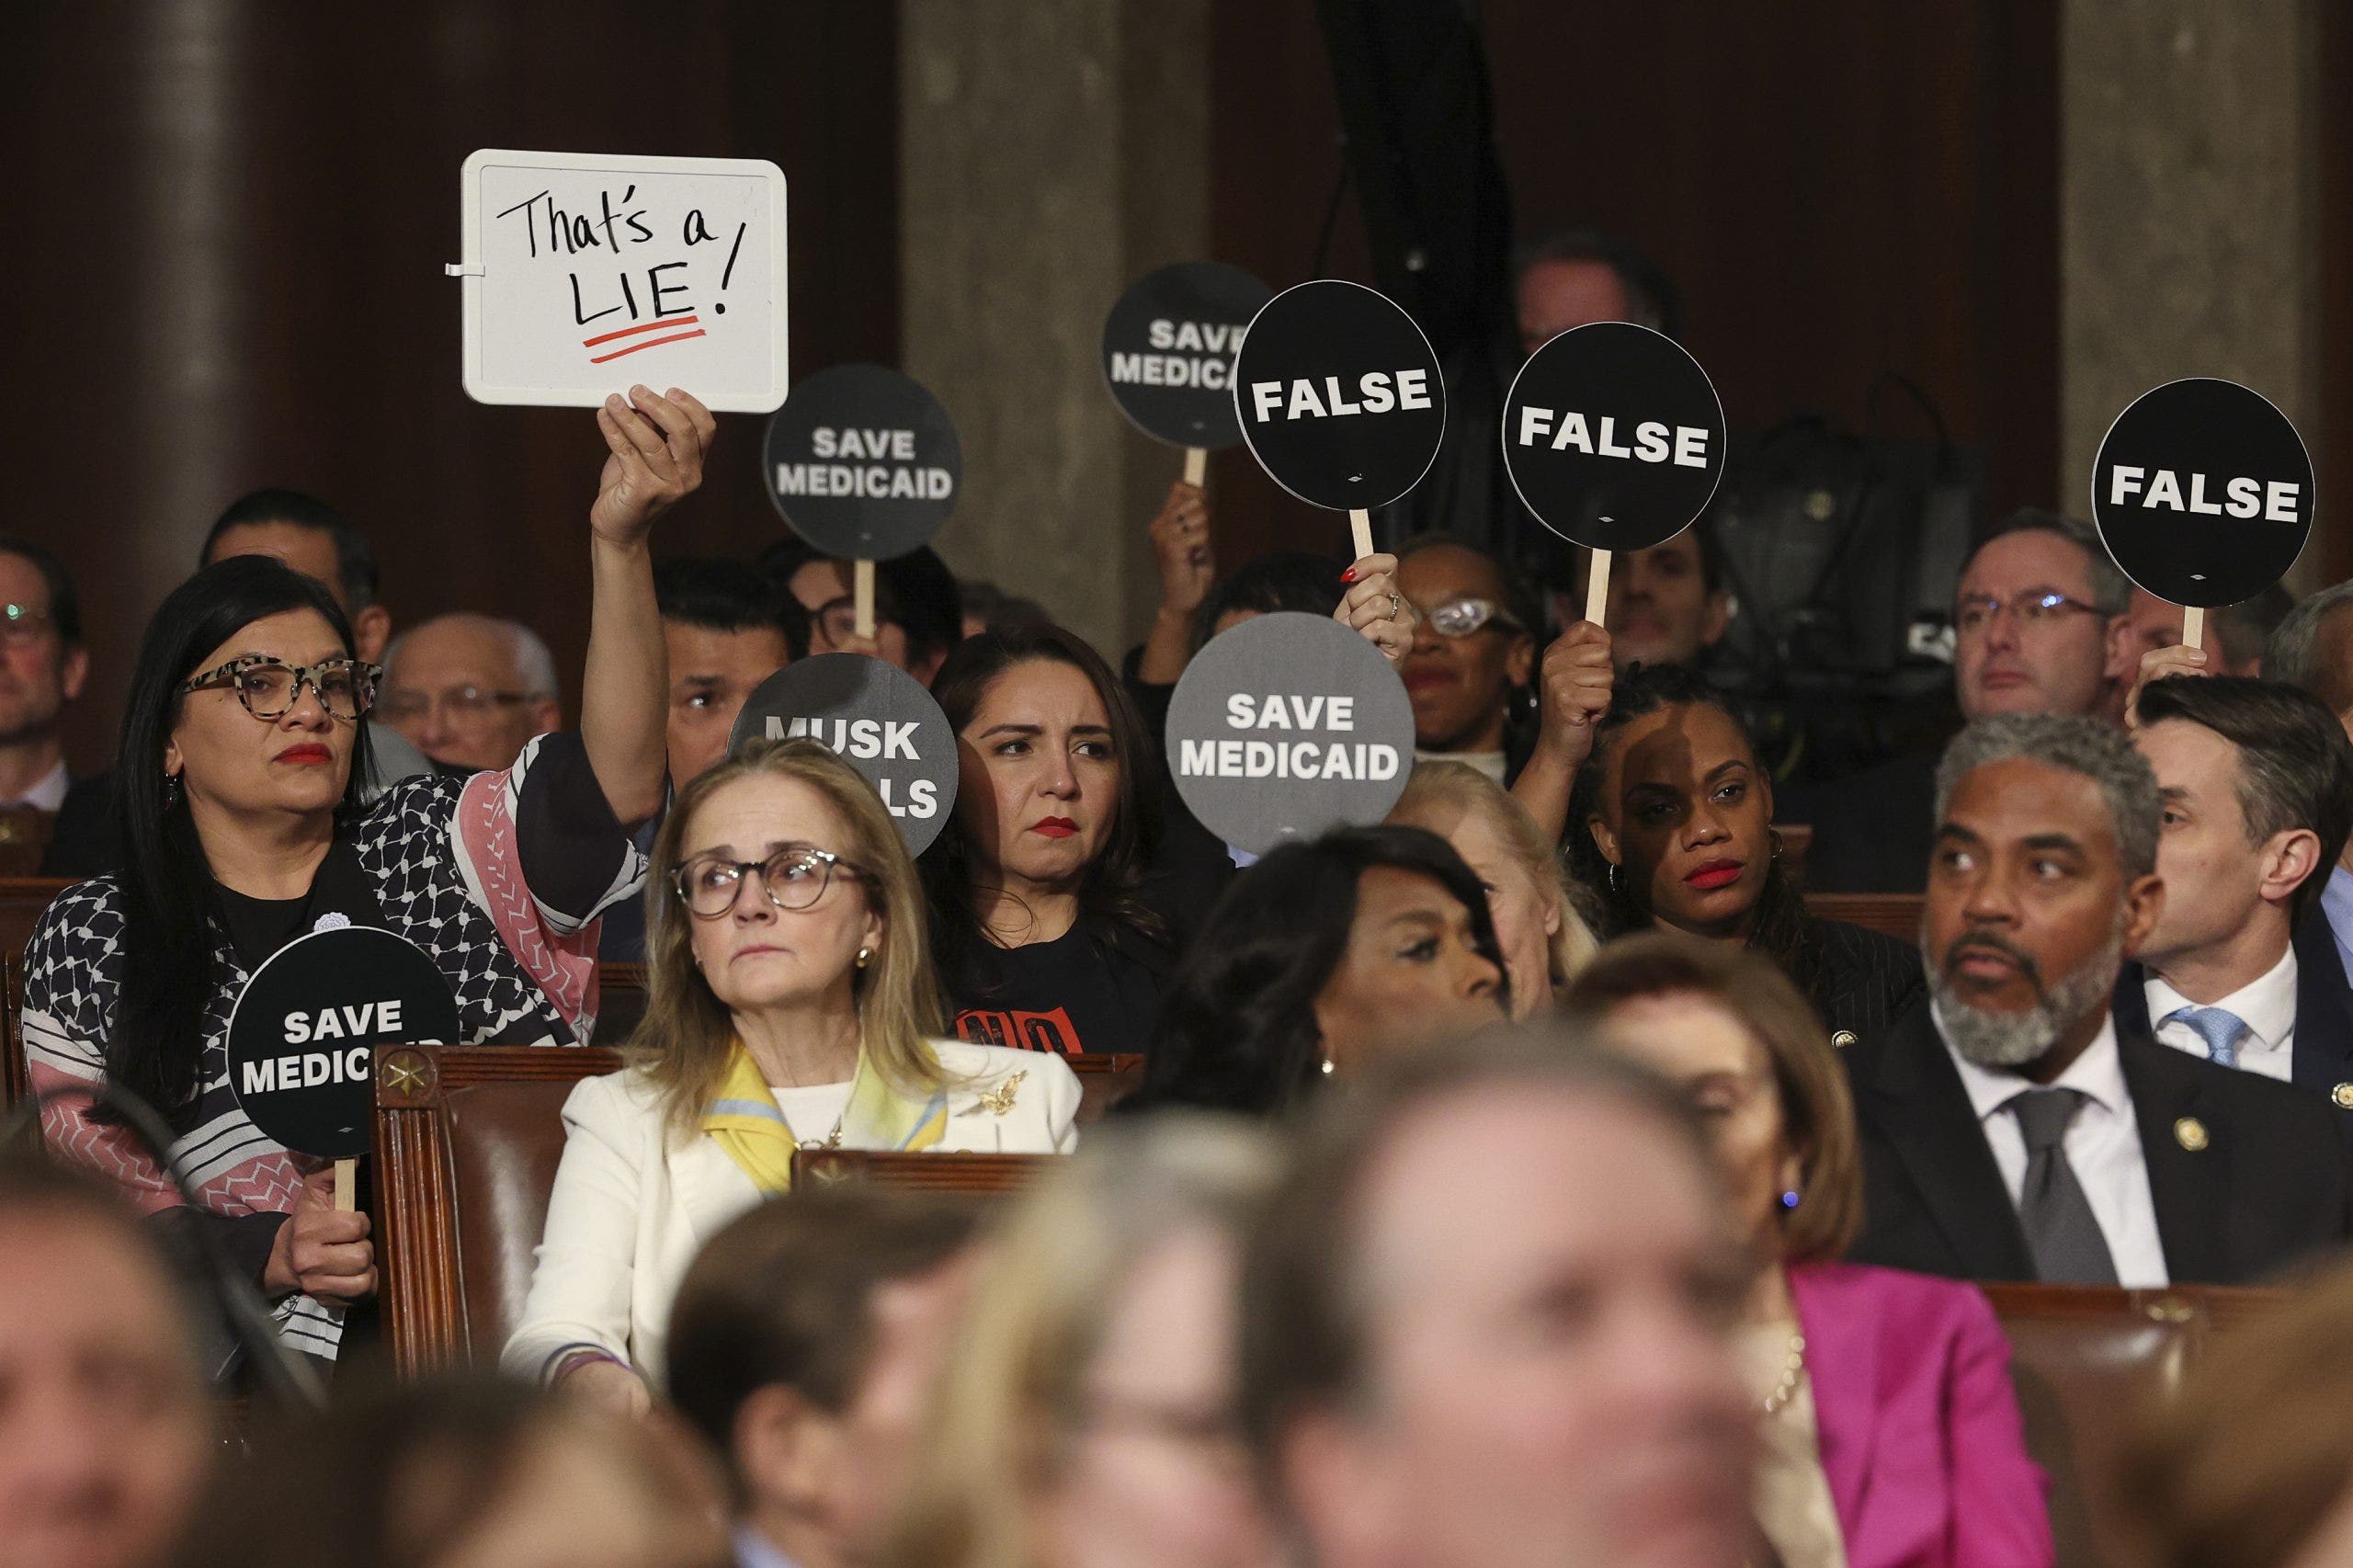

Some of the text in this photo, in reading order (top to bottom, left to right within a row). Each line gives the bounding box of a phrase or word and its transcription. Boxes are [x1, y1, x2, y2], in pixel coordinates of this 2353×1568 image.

[496, 185, 720, 257] That's a
[1110, 351, 1235, 391] MEDIC
[1251, 369, 1432, 423] FALSE
[812, 426, 915, 460] SAVE
[1519, 405, 1709, 469] FALSE
[777, 462, 953, 499] MEDICAID
[2110, 464, 2300, 523] FALSE
[1226, 693, 1354, 732] SAVE
[1180, 739, 1400, 781] MEDICAID
[284, 999, 403, 1044] SAVE
